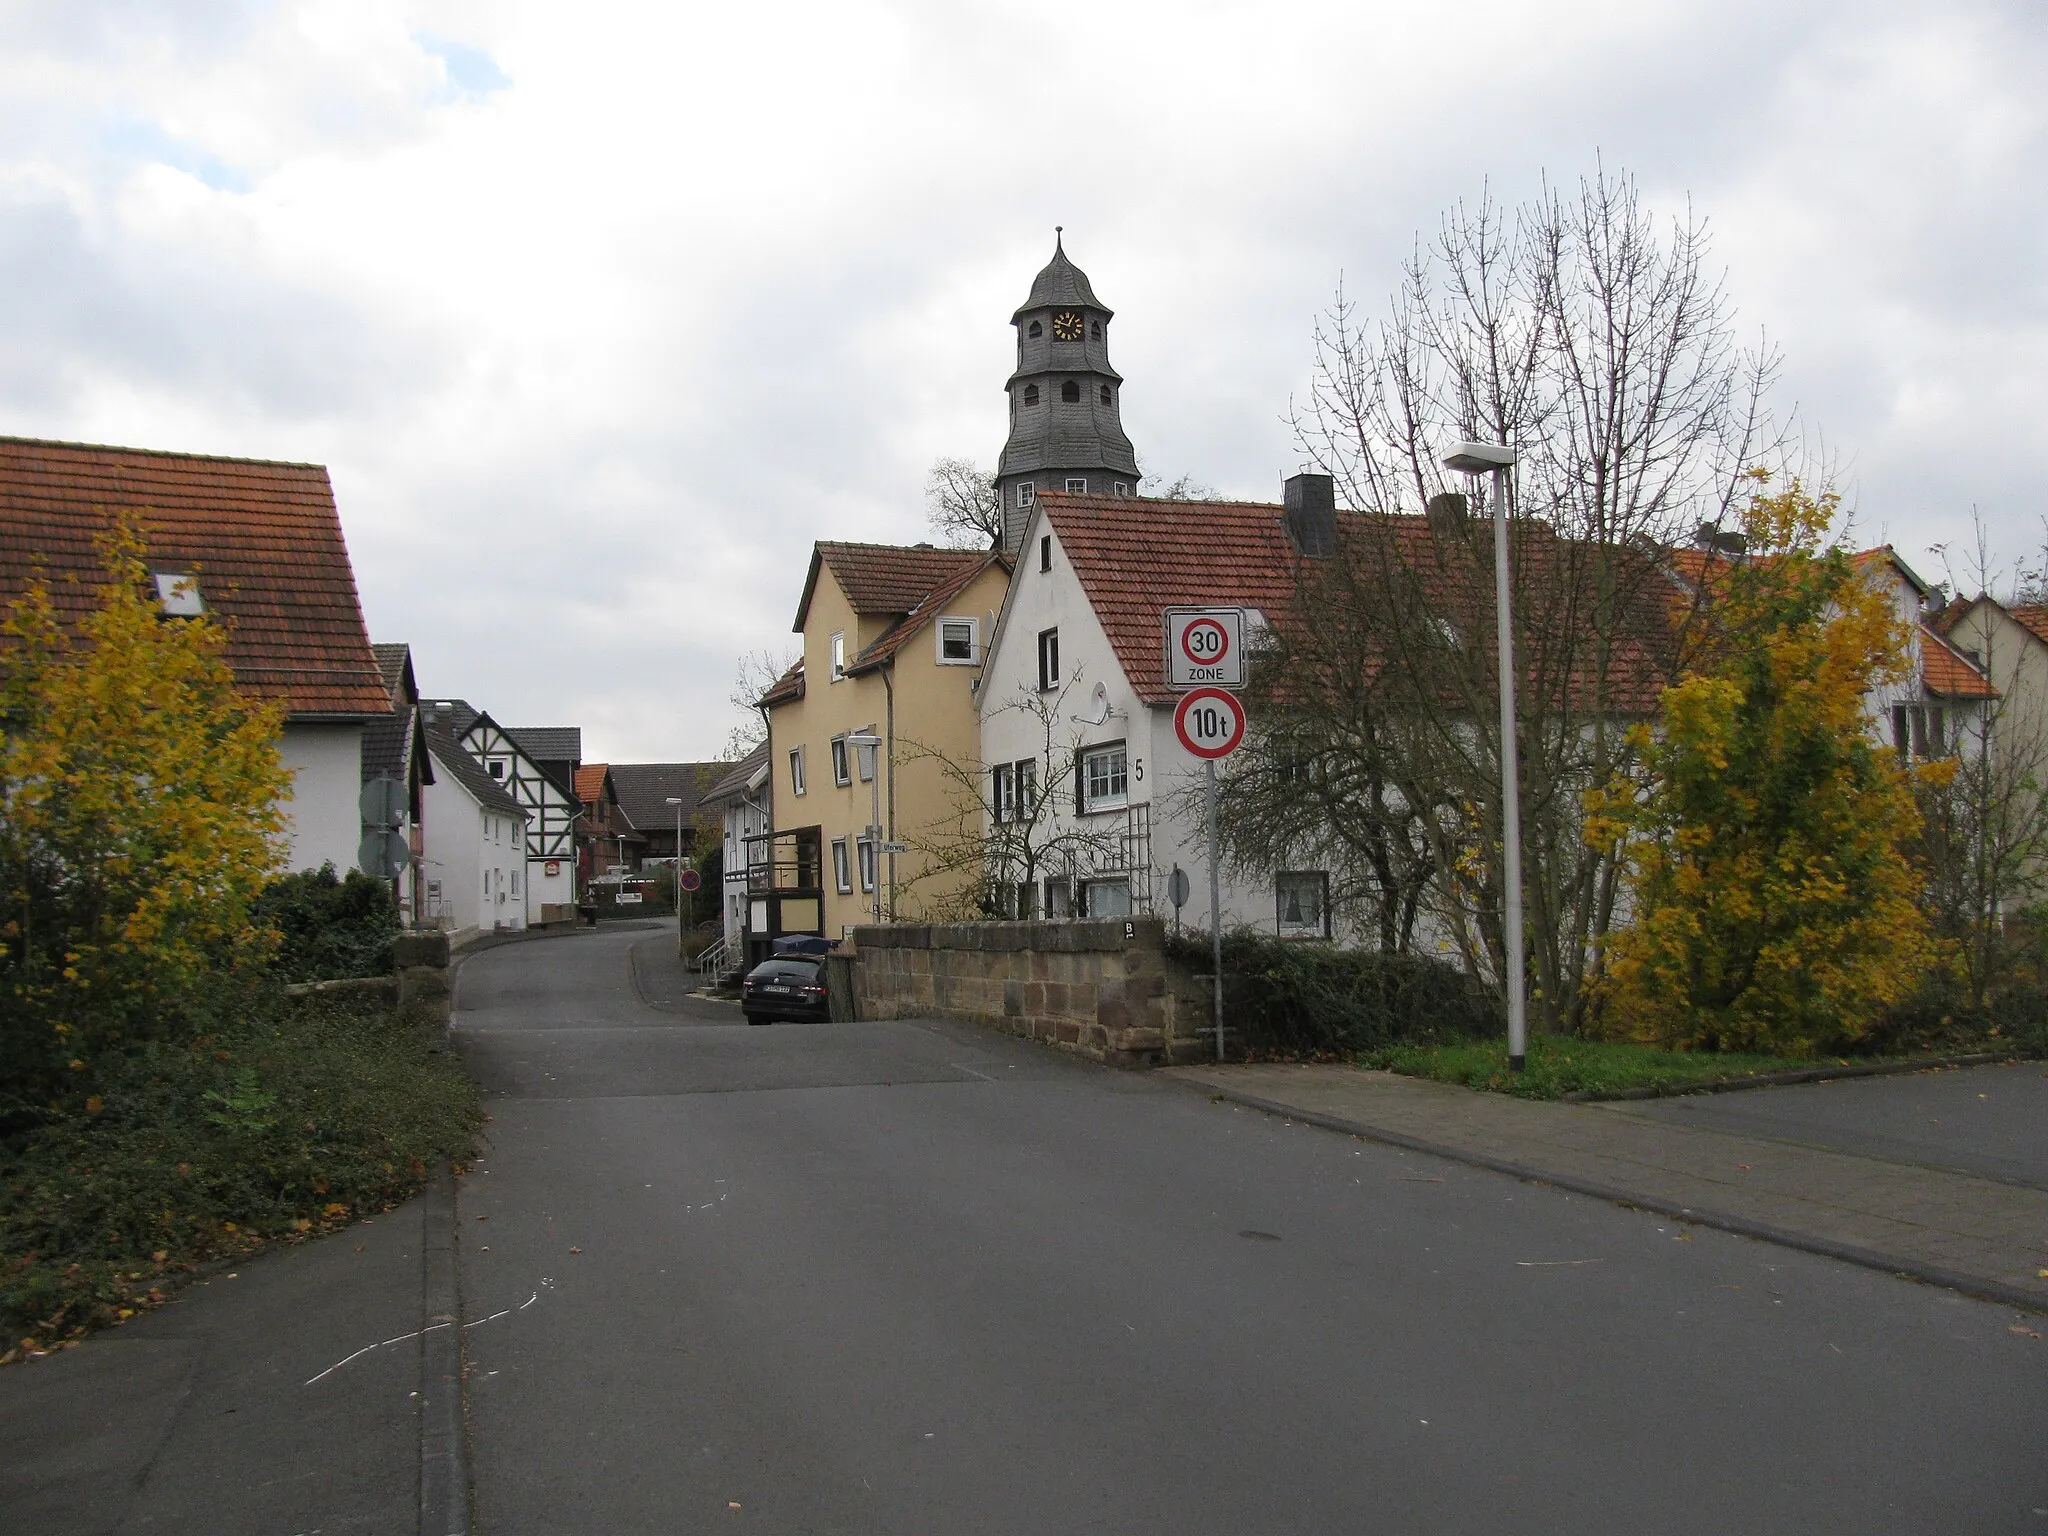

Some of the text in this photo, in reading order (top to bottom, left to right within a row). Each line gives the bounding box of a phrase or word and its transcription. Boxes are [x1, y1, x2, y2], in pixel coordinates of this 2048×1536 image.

[1191, 631, 1219, 653] 30
[1189, 668, 1224, 680] ZONE
[1135, 758, 1144, 781] 5
[1125, 922, 1133, 933] B
